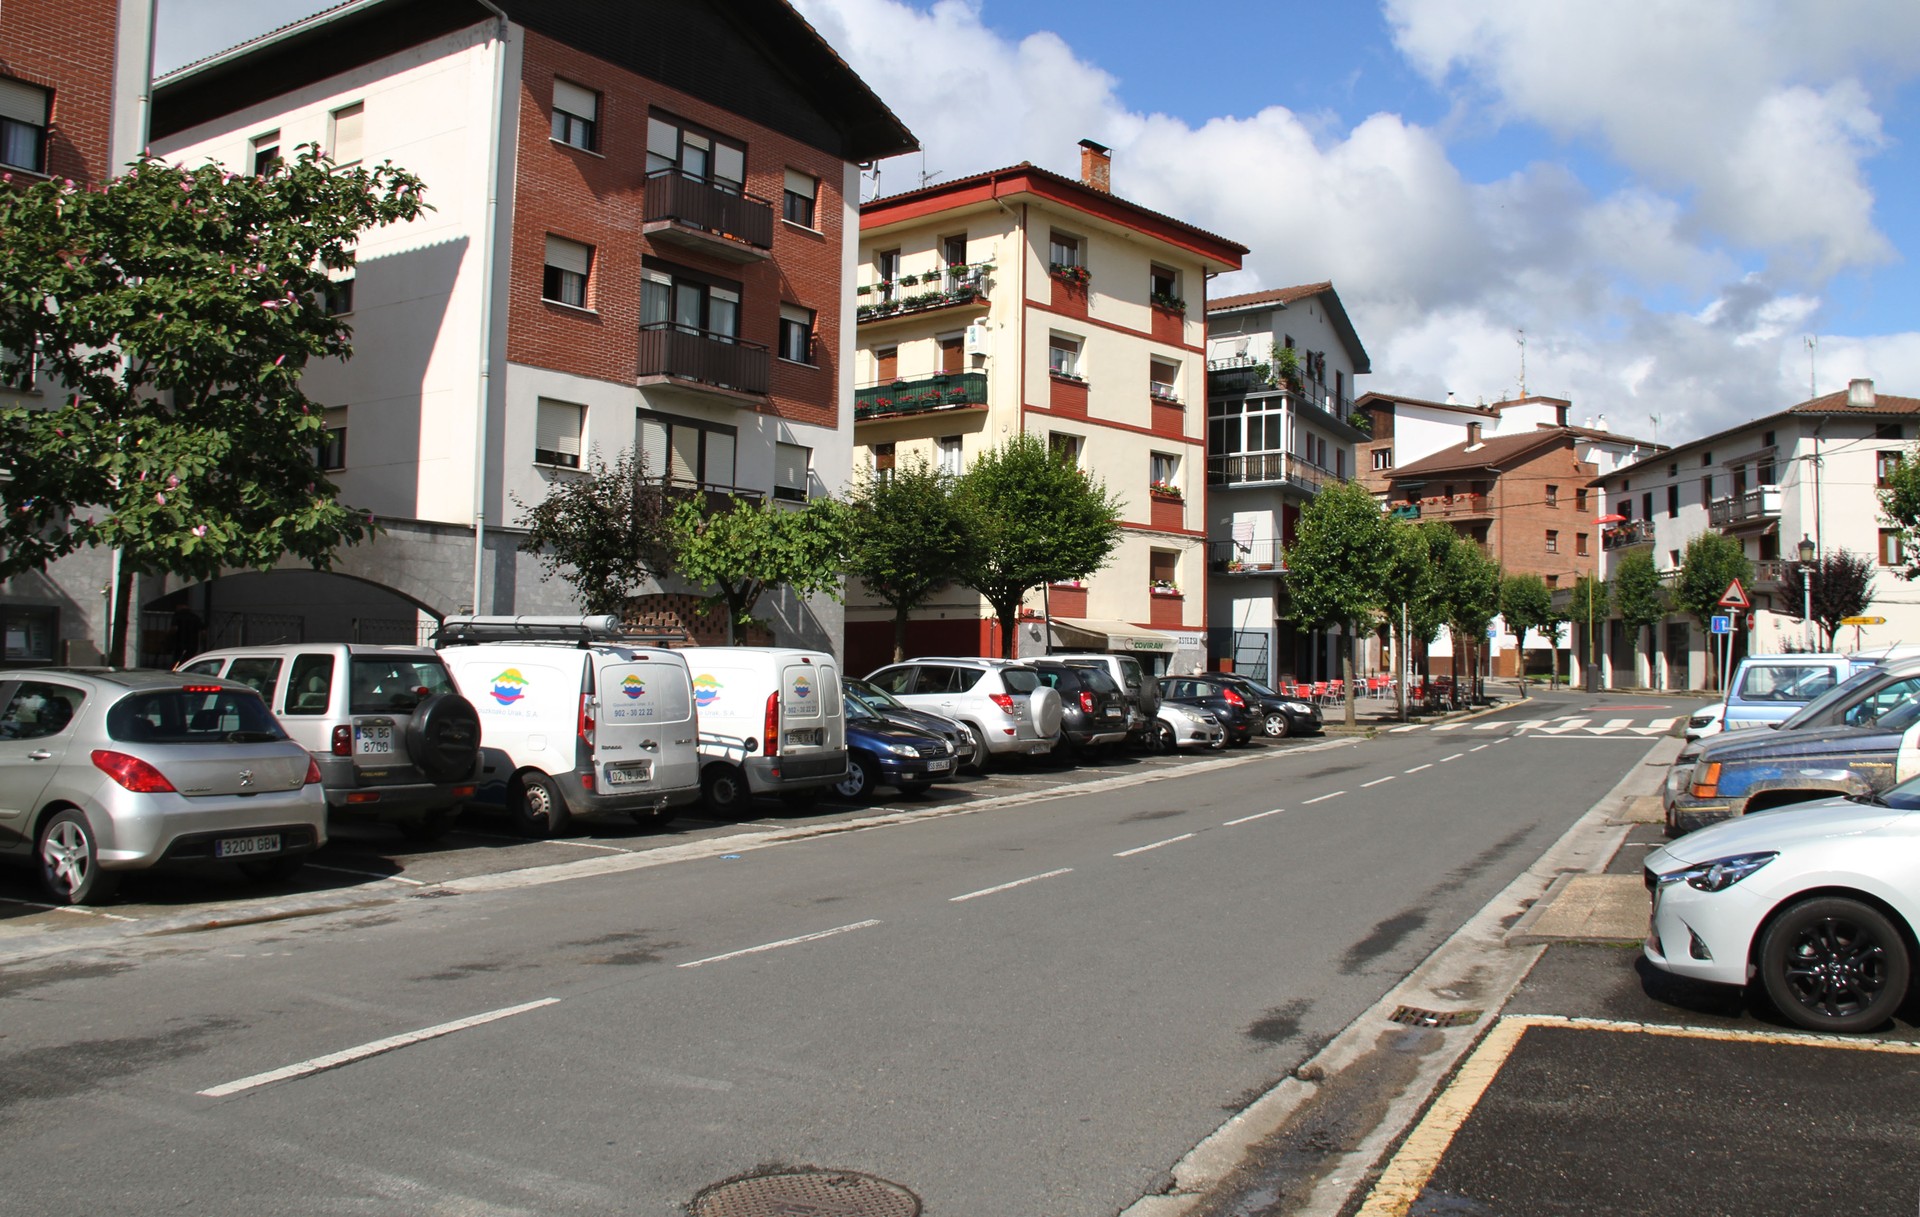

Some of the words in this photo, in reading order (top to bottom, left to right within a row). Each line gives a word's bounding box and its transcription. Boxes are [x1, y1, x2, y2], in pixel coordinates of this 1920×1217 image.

[1134, 641, 1163, 649] COVIRAN
[614, 709, 625, 717] 902
[630, 709, 637, 717] 30
[646, 708, 653, 716] 22
[362, 728, 374, 738] SS
[378, 728, 389, 738] BG
[363, 742, 389, 752] 8700
[612, 770, 632, 781] 0218
[224, 839, 254, 854] 3200
[257, 836, 278, 850] GBW
